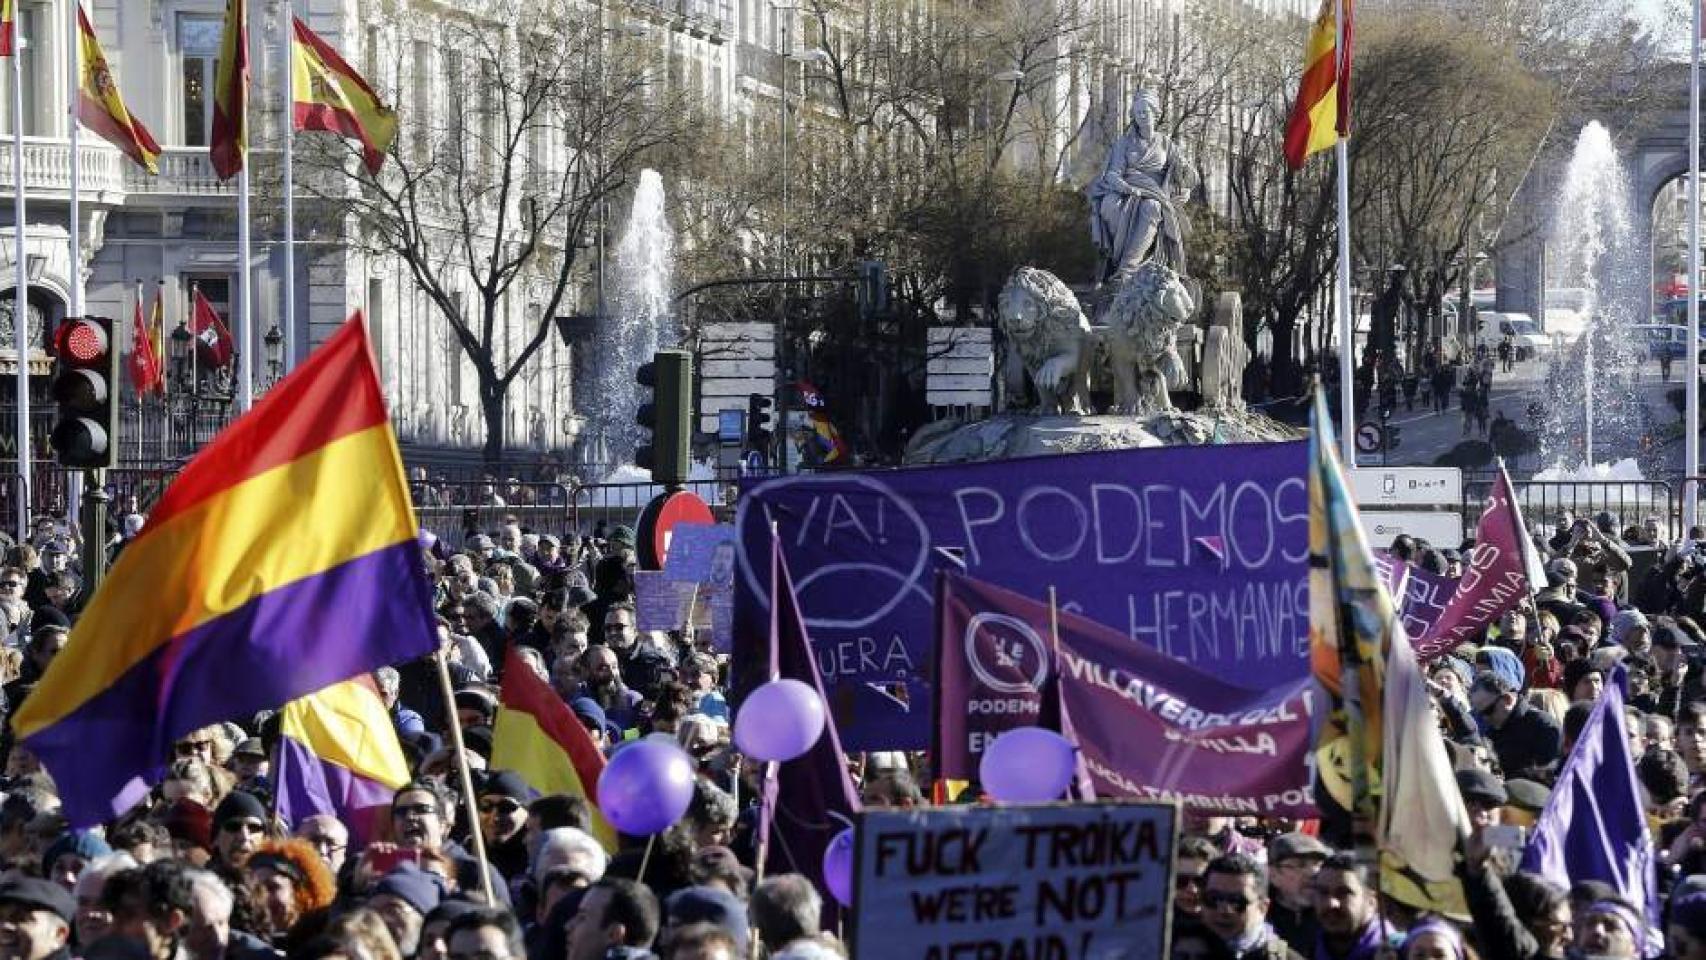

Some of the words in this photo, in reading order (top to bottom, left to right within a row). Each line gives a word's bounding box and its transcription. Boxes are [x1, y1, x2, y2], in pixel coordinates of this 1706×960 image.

[953, 477, 1309, 571] PODEMOS
[808, 634, 913, 676] UERA
[968, 699, 1040, 714] PODEM
[874, 826, 988, 877] FUCK
[1034, 870, 1141, 926] NOT
